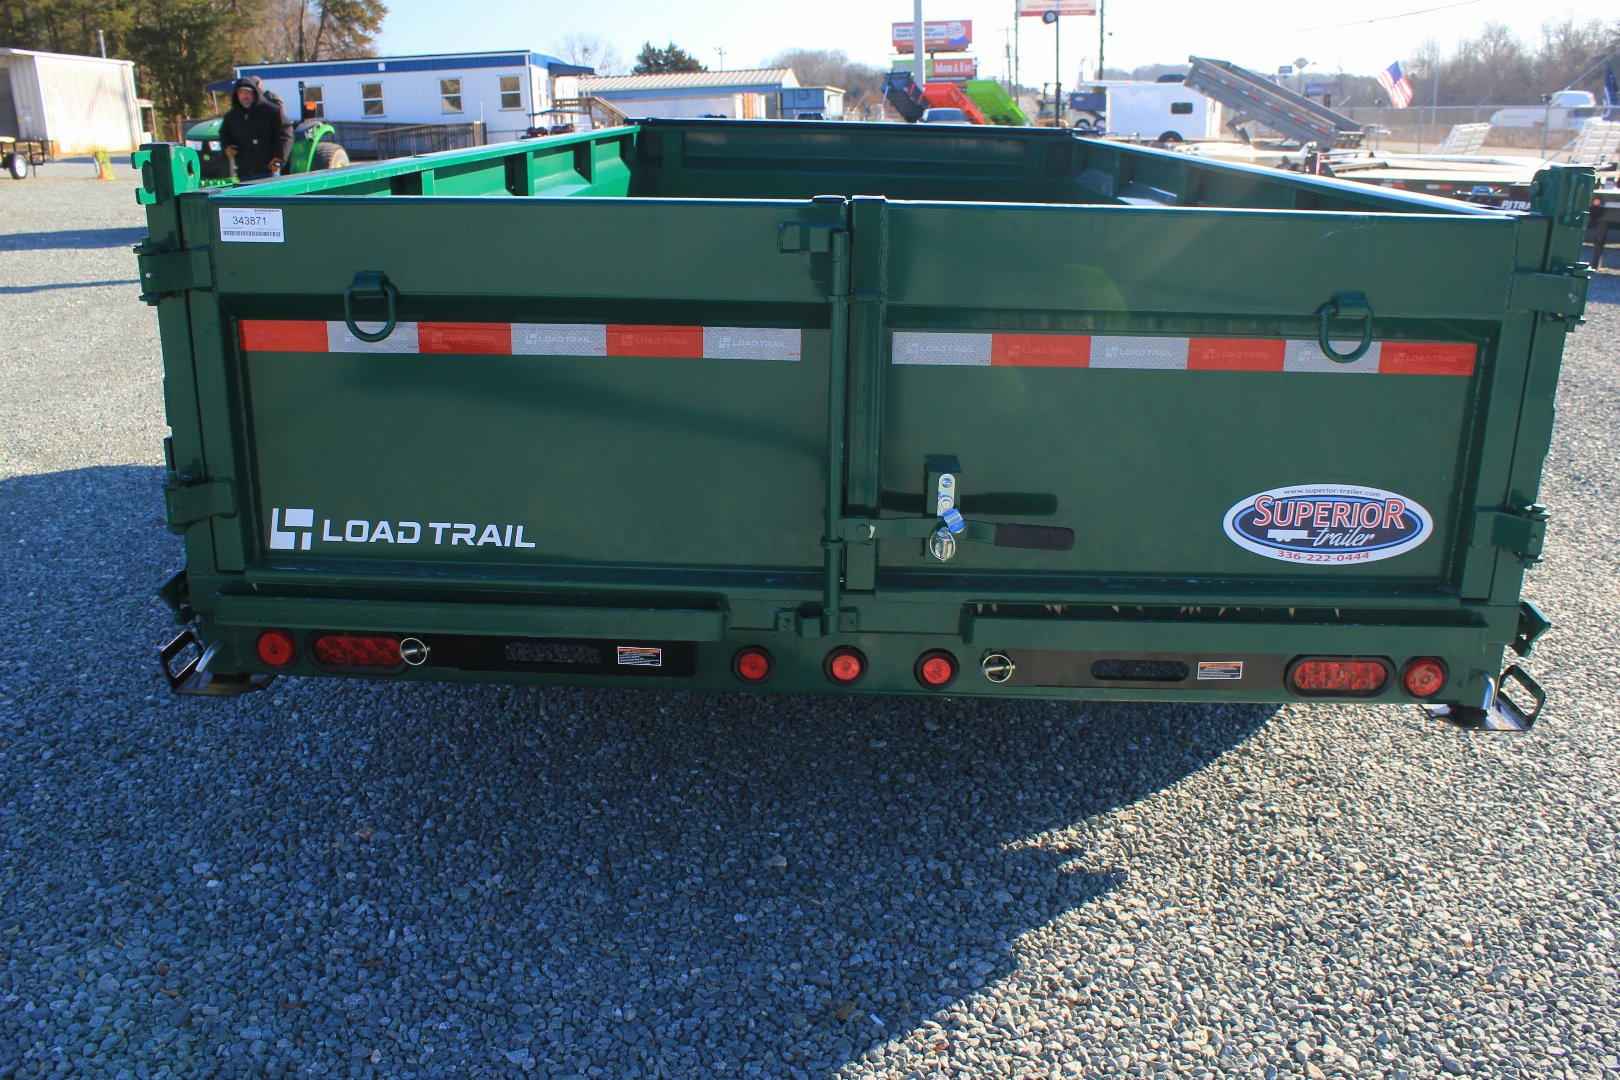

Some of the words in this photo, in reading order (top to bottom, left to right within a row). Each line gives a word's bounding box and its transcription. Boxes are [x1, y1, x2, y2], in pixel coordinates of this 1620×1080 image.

[232, 216, 267, 225] 343871
[538, 335, 564, 343] LOAD
[731, 339, 759, 347] LOAD
[760, 339, 785, 348] TRAIL
[1283, 487, 1381, 497] www.superior-trailer.com
[1252, 495, 1405, 530] SUPERIOR
[322, 519, 422, 544] LOAD
[428, 522, 536, 548] TRAIL
[1312, 526, 1375, 547] trailer
[1277, 550, 1370, 562] 336-222-0444
